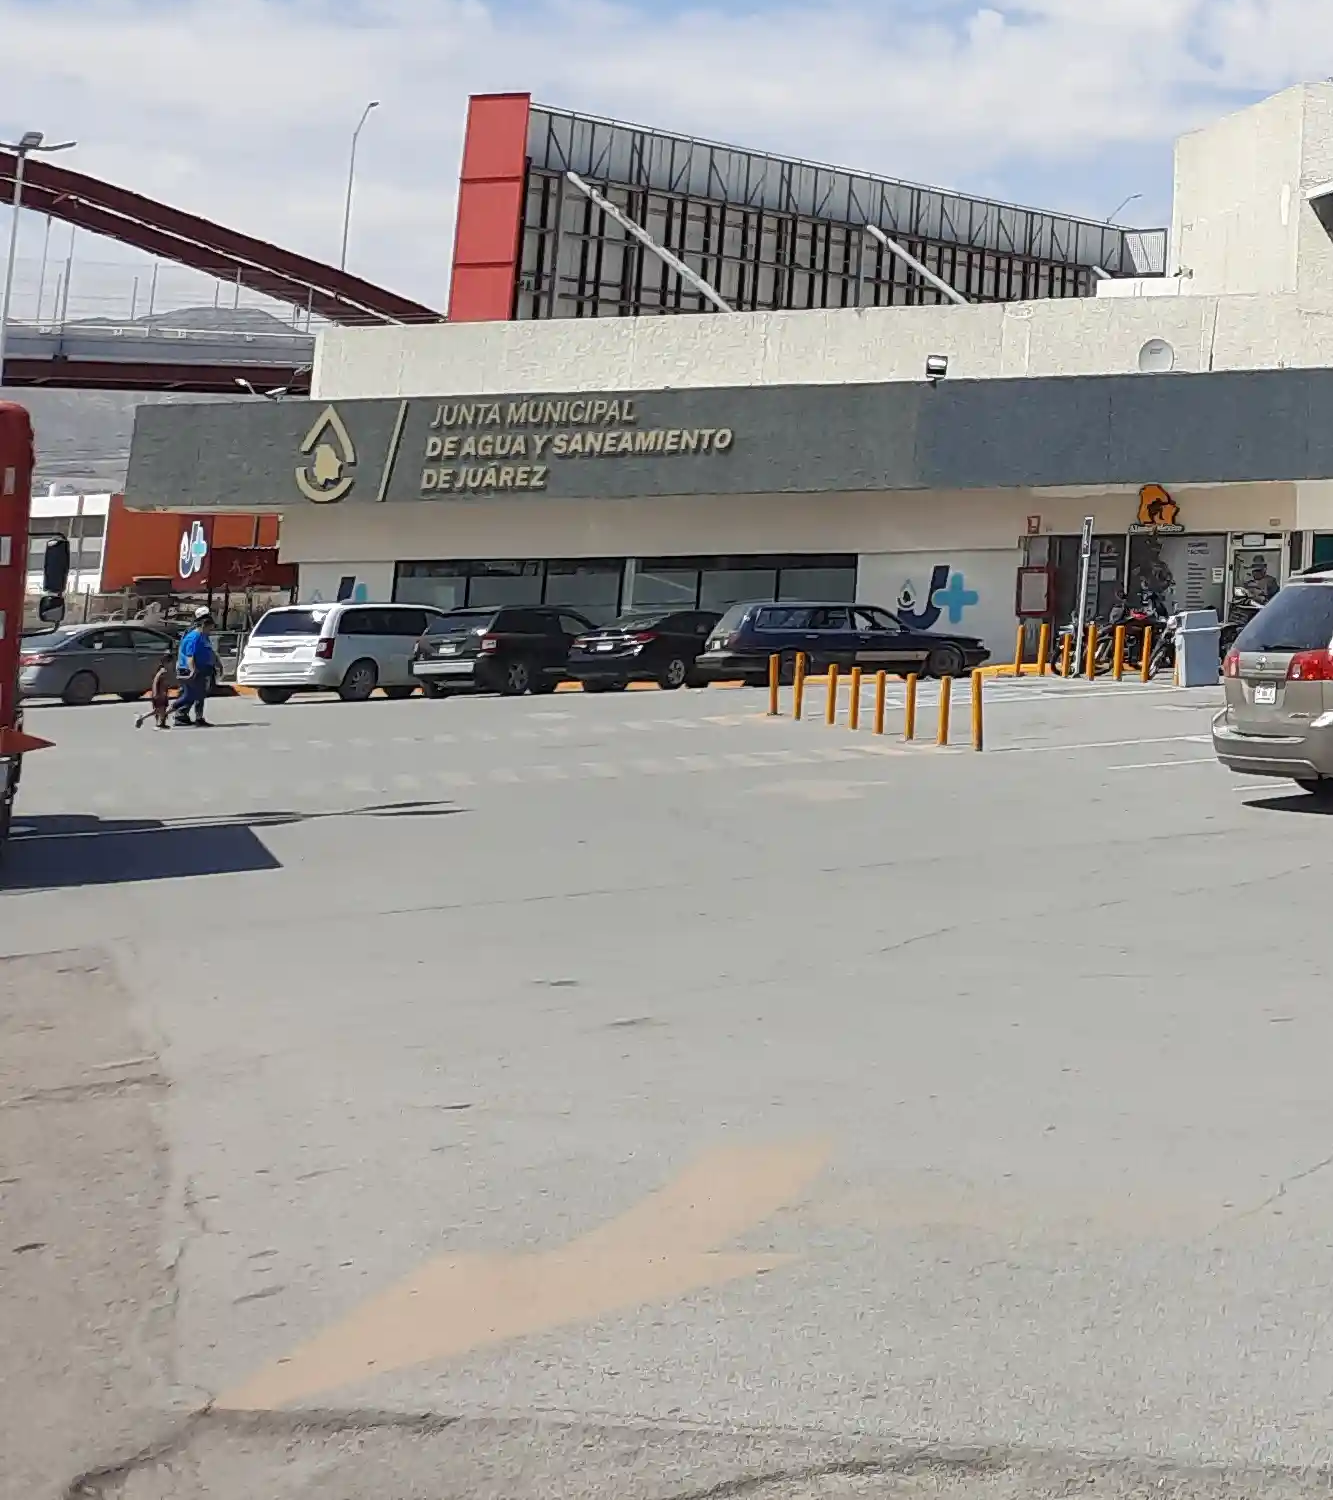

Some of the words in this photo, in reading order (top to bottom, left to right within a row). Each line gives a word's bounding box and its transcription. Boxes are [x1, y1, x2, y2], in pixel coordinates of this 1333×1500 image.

[431, 403, 501, 428] JUNTA
[507, 400, 637, 425] MUNICIPAL
[425, 435, 457, 457] DE
[457, 434, 526, 456] AGUA
[532, 433, 553, 454] Y
[551, 428, 734, 455] SANEAMIENTO
[421, 467, 453, 489] DE
[453, 461, 547, 489] JUÁREZ
